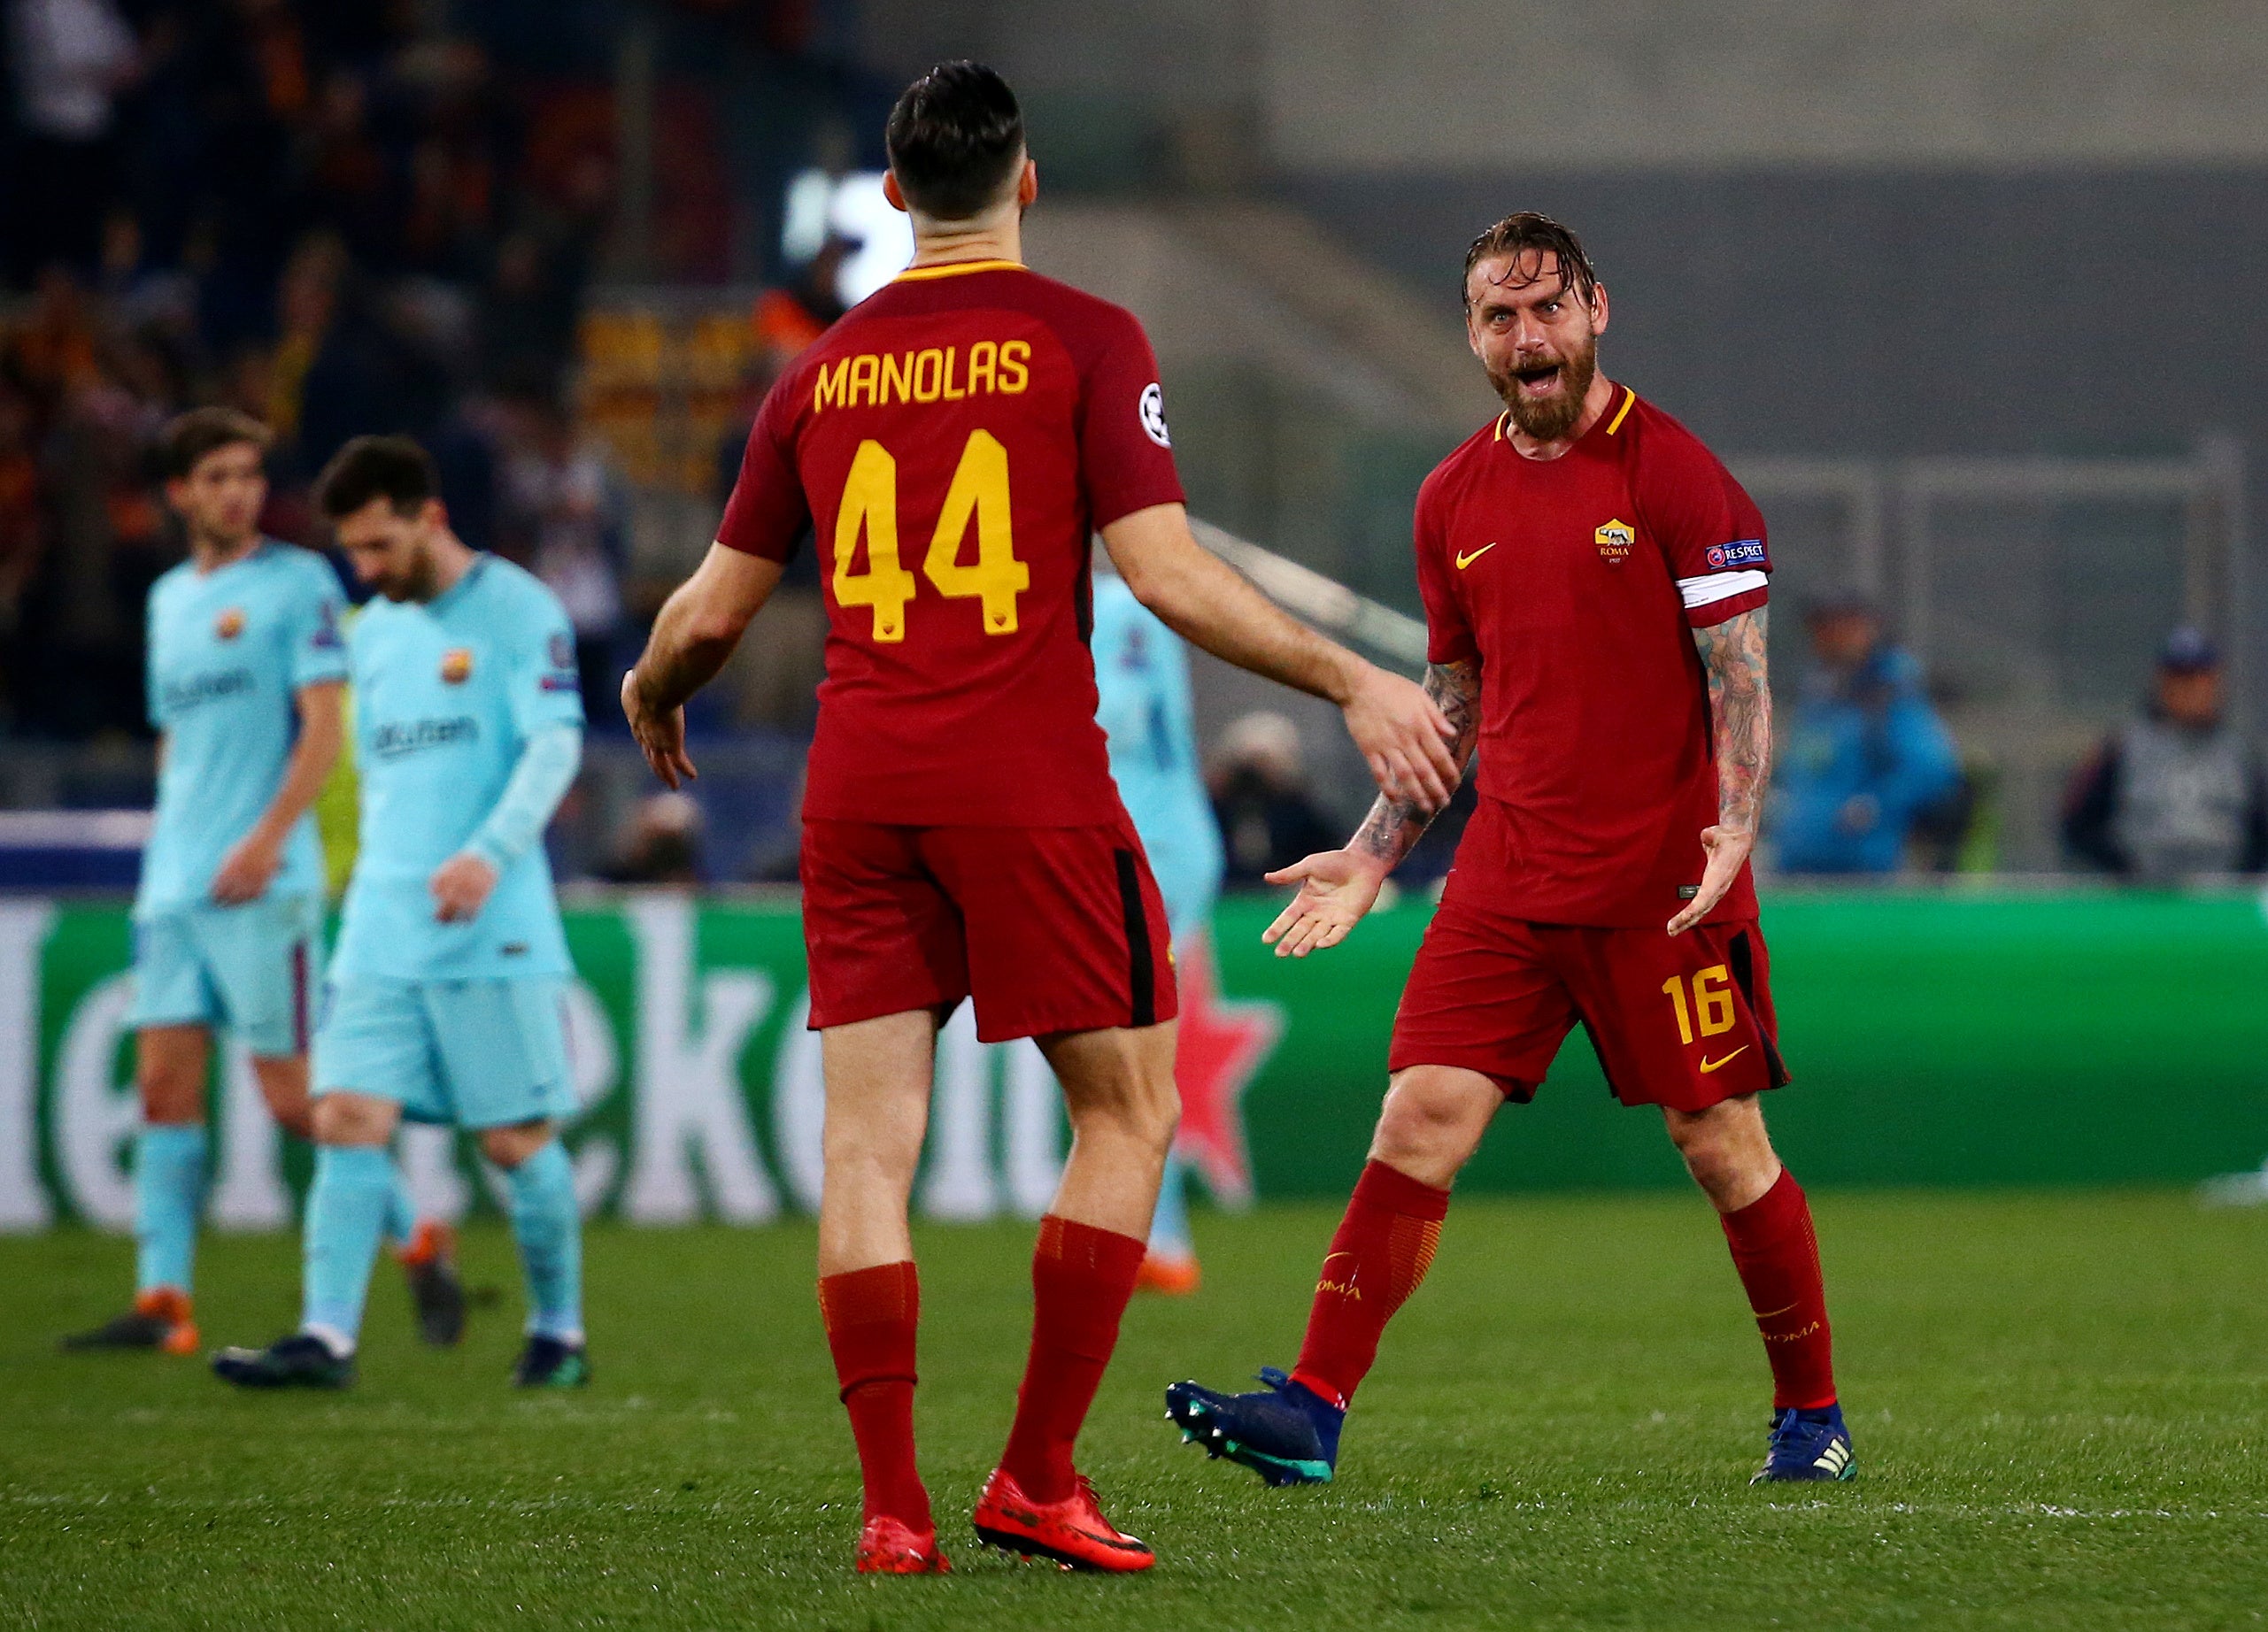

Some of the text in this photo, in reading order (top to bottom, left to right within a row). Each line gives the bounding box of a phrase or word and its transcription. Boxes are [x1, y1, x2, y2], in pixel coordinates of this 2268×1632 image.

[814, 339, 1031, 413] MANOLAS
[832, 428, 1030, 643] 44
[1600, 547, 1630, 556] ROMA
[1724, 544, 1763, 560] RESPECT
[1662, 964, 1736, 1045] 16
[0, 892, 1071, 1232] eiekn
[1315, 1279, 1362, 1301] OMA
